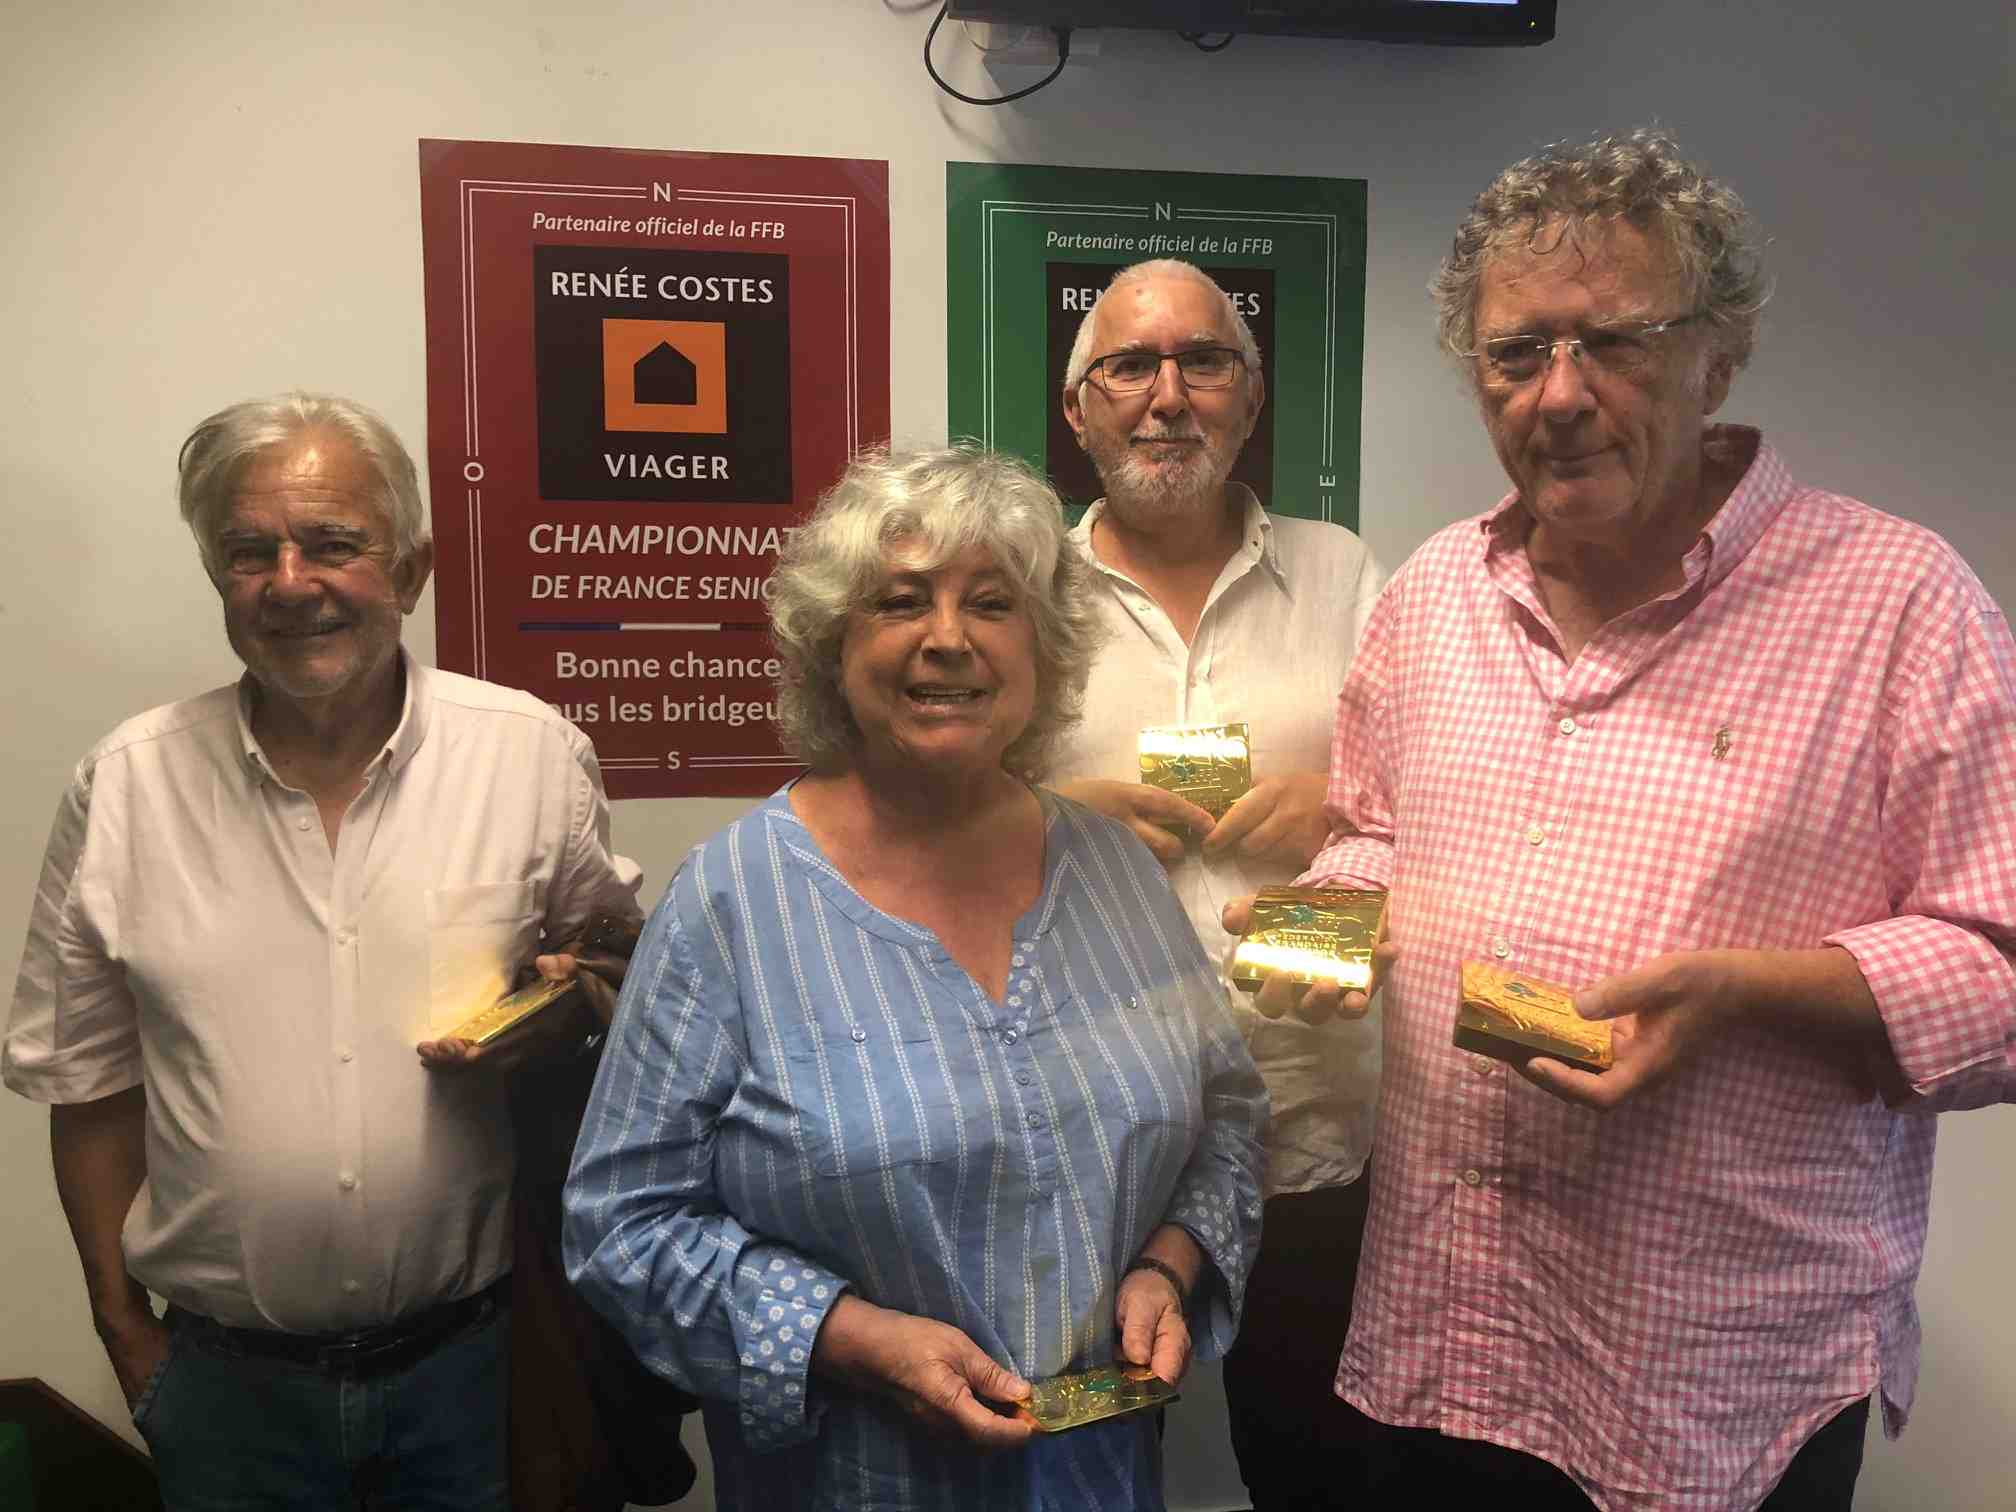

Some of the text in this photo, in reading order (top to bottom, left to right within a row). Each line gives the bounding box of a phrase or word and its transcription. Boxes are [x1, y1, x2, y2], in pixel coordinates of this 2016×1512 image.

[652, 182, 672, 202] N
[532, 212, 785, 239] Partenaire officiel de la FFB
[1046, 231, 1273, 255] Partenaire officiel de la FFB
[551, 266, 775, 304] RENÉE COSTES
[604, 454, 730, 481] VIAGER
[531, 575, 570, 599] DE
[578, 575, 691, 600] FRANCE
[556, 650, 782, 679] Bonne chance
[609, 695, 653, 723] les
